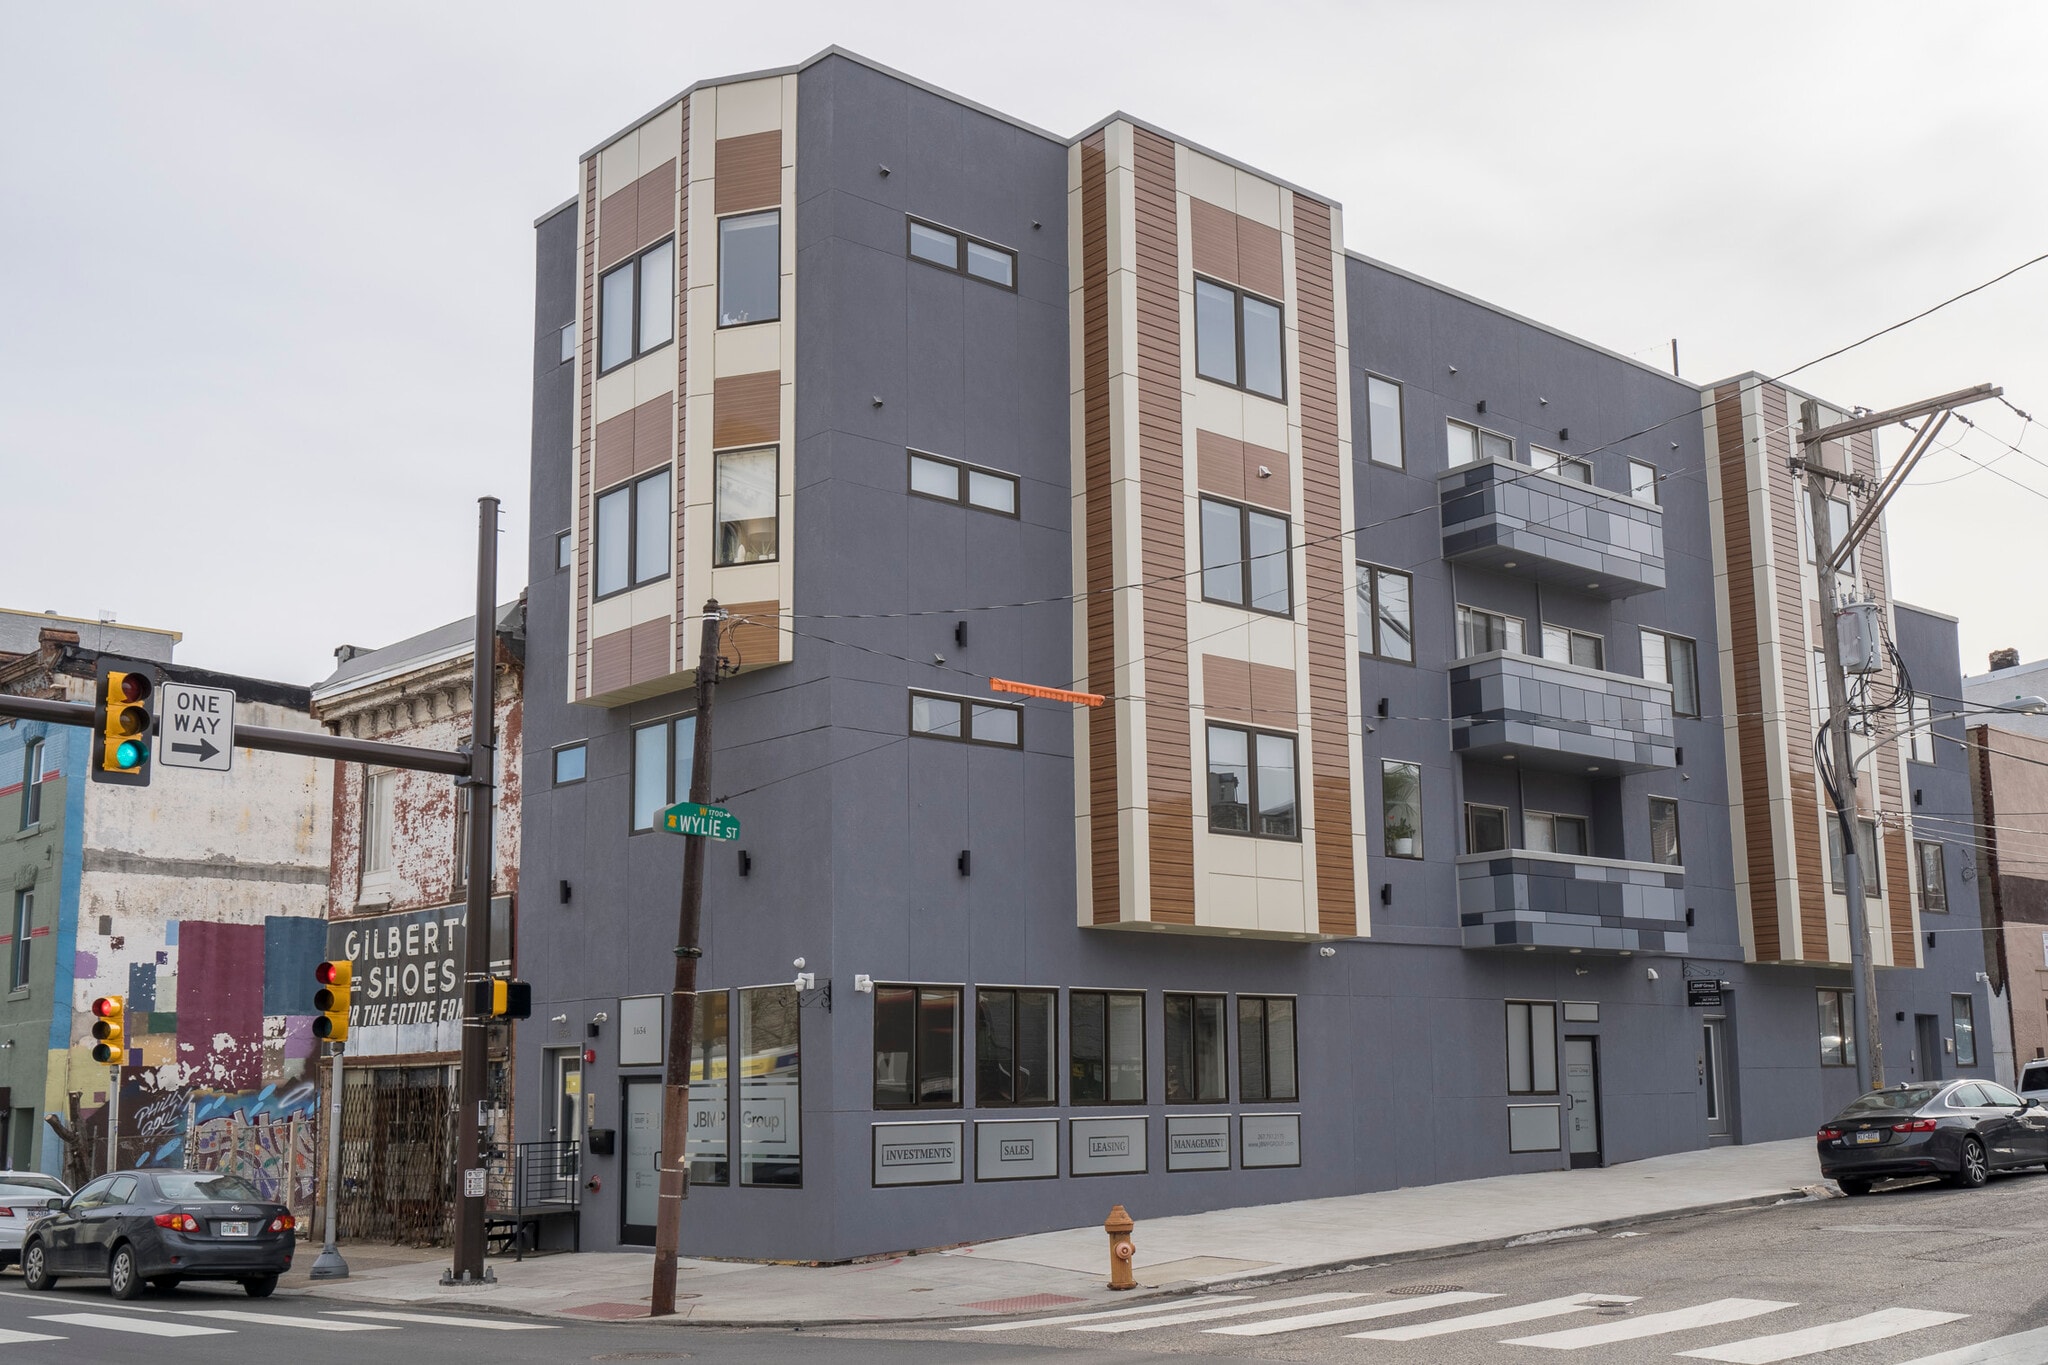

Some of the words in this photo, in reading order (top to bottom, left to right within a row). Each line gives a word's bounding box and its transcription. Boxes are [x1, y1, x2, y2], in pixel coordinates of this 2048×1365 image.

[177, 692, 220, 713] ONE
[174, 713, 221, 735] WAY
[699, 807, 708, 816] W
[708, 809, 724, 818] 1700
[680, 814, 721, 836] WYLIE
[726, 826, 738, 839] ST
[367, 958, 456, 999] SHOES
[363, 1003, 387, 1027] THE
[389, 1001, 437, 1026] ENTIRE
[693, 1111, 726, 1128] JBMP
[743, 1110, 780, 1133] Group
[886, 1147, 952, 1161] INVESTMENTS
[1004, 1144, 1030, 1156] SALES
[1092, 1141, 1127, 1152] LEASING
[1174, 1138, 1225, 1149] MANAGEMENT
